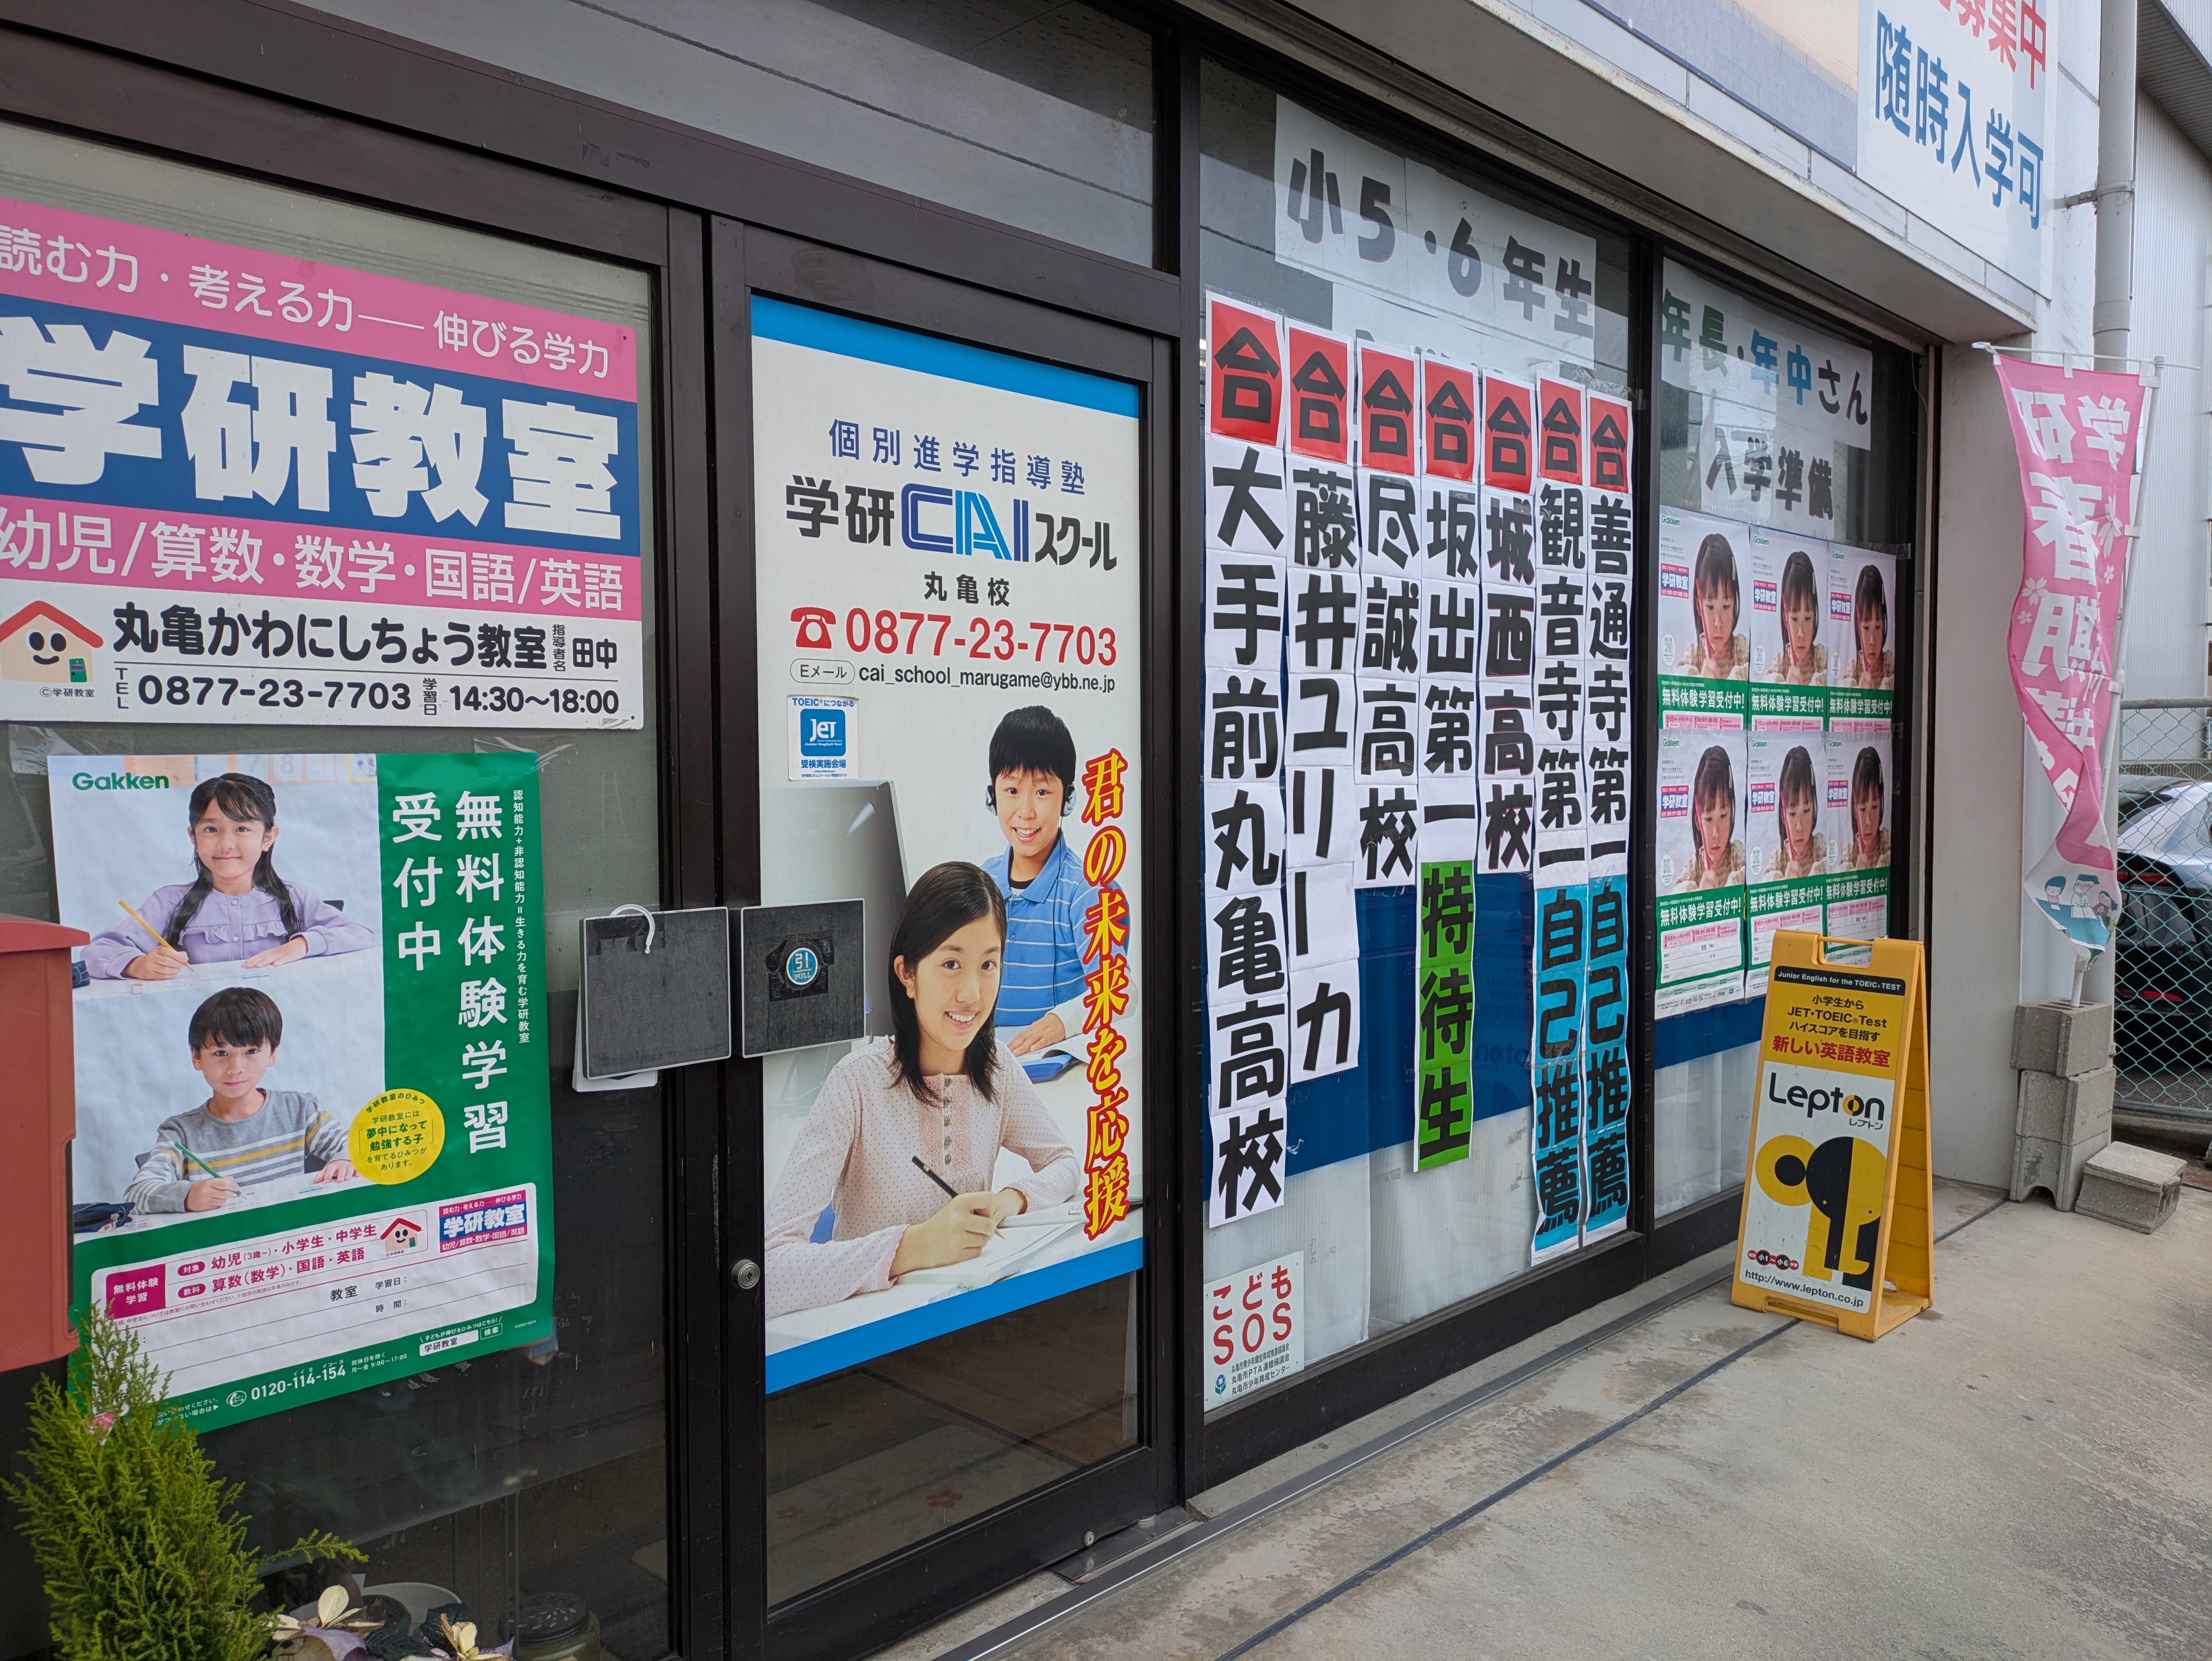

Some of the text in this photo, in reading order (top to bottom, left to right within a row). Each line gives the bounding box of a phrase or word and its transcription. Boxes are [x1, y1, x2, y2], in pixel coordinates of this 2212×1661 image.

[1939, 0, 2046, 91] 集中
[1875, 10, 2044, 231] 随時入学可
[1287, 147, 1594, 340] 小5・6年生
[1662, 288, 1868, 425] 年長・年中さん
[1214, 326, 1280, 425] 合
[1292, 351, 1346, 443] 合
[1363, 369, 1413, 456] 合
[0, 316, 621, 540] 学研教室
[1427, 380, 1473, 464] 合
[1486, 396, 1531, 477] 合
[1542, 397, 1581, 474] 合
[829, 418, 1085, 495] 個別進学指導塾
[1591, 414, 1626, 487] 合
[1705, 426, 1834, 520] 入学準備
[786, 474, 1118, 571] 学研CAIスクール
[1661, 515, 1680, 526] Gakken
[1754, 536, 1770, 545] Gakken
[1831, 551, 1845, 560] Gakken
[0, 505, 624, 611] 幼児/算数・数学・国語/英語
[924, 571, 1010, 607] 丸亀校
[1662, 573, 1688, 589] 学研教室
[1755, 588, 1776, 604] 学研教室
[1832, 600, 1850, 613] 学研教室
[112, 600, 619, 672] 丸亀かわにしちょう教室 指導者名 田中
[846, 607, 1117, 666] 0877-23-7703
[1424, 490, 1478, 823] 坂出第一
[114, 667, 129, 709] TEL
[138, 675, 411, 710] 0877-23-7703
[422, 677, 437, 716] 学習日
[800, 664, 1115, 692] Eメール cai_school_marugame@ybb.ne.jp
[1360, 474, 1419, 880] 尽誠高校
[1485, 497, 1535, 871] 城西高校
[1538, 483, 1586, 868] 観音寺第一
[1588, 494, 1632, 858] 善通寺第一
[1662, 687, 1744, 709] 無料体験学習受付中!
[1751, 694, 1824, 713] 無料体験学習受付中!
[1830, 697, 1892, 715] 無料体験学習受付中!
[1663, 739, 1680, 747] Gakken
[1752, 740, 1767, 748] Gakken
[801, 760, 846, 768] 受検実施会場
[1293, 467, 1358, 1072] 藤井ユリーカ
[72, 772, 169, 790] Gakken
[1828, 787, 1847, 800] 学研教室
[1663, 794, 1688, 809] 学研教室
[1752, 790, 1774, 805] 学研教室
[1211, 445, 1285, 1219] 大手前丸亀高校
[392, 792, 443, 971] 受付中
[1826, 877, 1887, 900] 無料体験学習受付中!
[1661, 897, 1741, 927] 無料体験学習受付中!
[1750, 886, 1823, 913] 無料体験学習受付中!
[455, 790, 508, 1154] 無料体験学習
[794, 972, 811, 981] PULL
[1779, 971, 1800, 979] Junior
[1802, 974, 1827, 983] English
[1083, 747, 1128, 1241] 君の未来を応援
[1812, 995, 1864, 1010] 小学生から
[1419, 867, 1474, 1162] 特待生
[1789, 1021, 1880, 1042] ハイスコアを目指す
[1536, 889, 1582, 1235] 自己推薦
[1587, 879, 1629, 1218] 自己推薦
[1772, 1035, 1891, 1068] 新しい英語教室
[365, 1093, 425, 1113] 学研教室のひみつ
[1769, 1072, 1885, 1121] Lepton
[366, 1120, 427, 1139] 夢中になって
[372, 1110, 420, 1124] 学研教室には
[1849, 1118, 1883, 1130] レプトン
[367, 1146, 427, 1163] を育てるひみつが
[370, 1133, 423, 1152] 勉強する子
[381, 1159, 412, 1170] あります。
[443, 1204, 525, 1238] 学研教室
[183, 1264, 199, 1273] 対象
[113, 1277, 158, 1294] 無料体験
[126, 1292, 147, 1305] 学習
[183, 1287, 200, 1296] 教科
[330, 1285, 357, 1301] 教室
[1213, 1264, 1292, 1321] こども
[1745, 1269, 1863, 1308] http://www.lepton.co.jp
[424, 1338, 458, 1352] 学研教室
[484, 1327, 498, 1336] 検索
[1213, 1302, 1292, 1365] SOS
[351, 1352, 385, 1366] 祝休日を除く
[1232, 1353, 1289, 1384] 丸亀市PTA連絡協議会
[251, 1365, 345, 1400] 0120-114-154
[1232, 1366, 1289, 1395] 丸亀市少年育成センター
